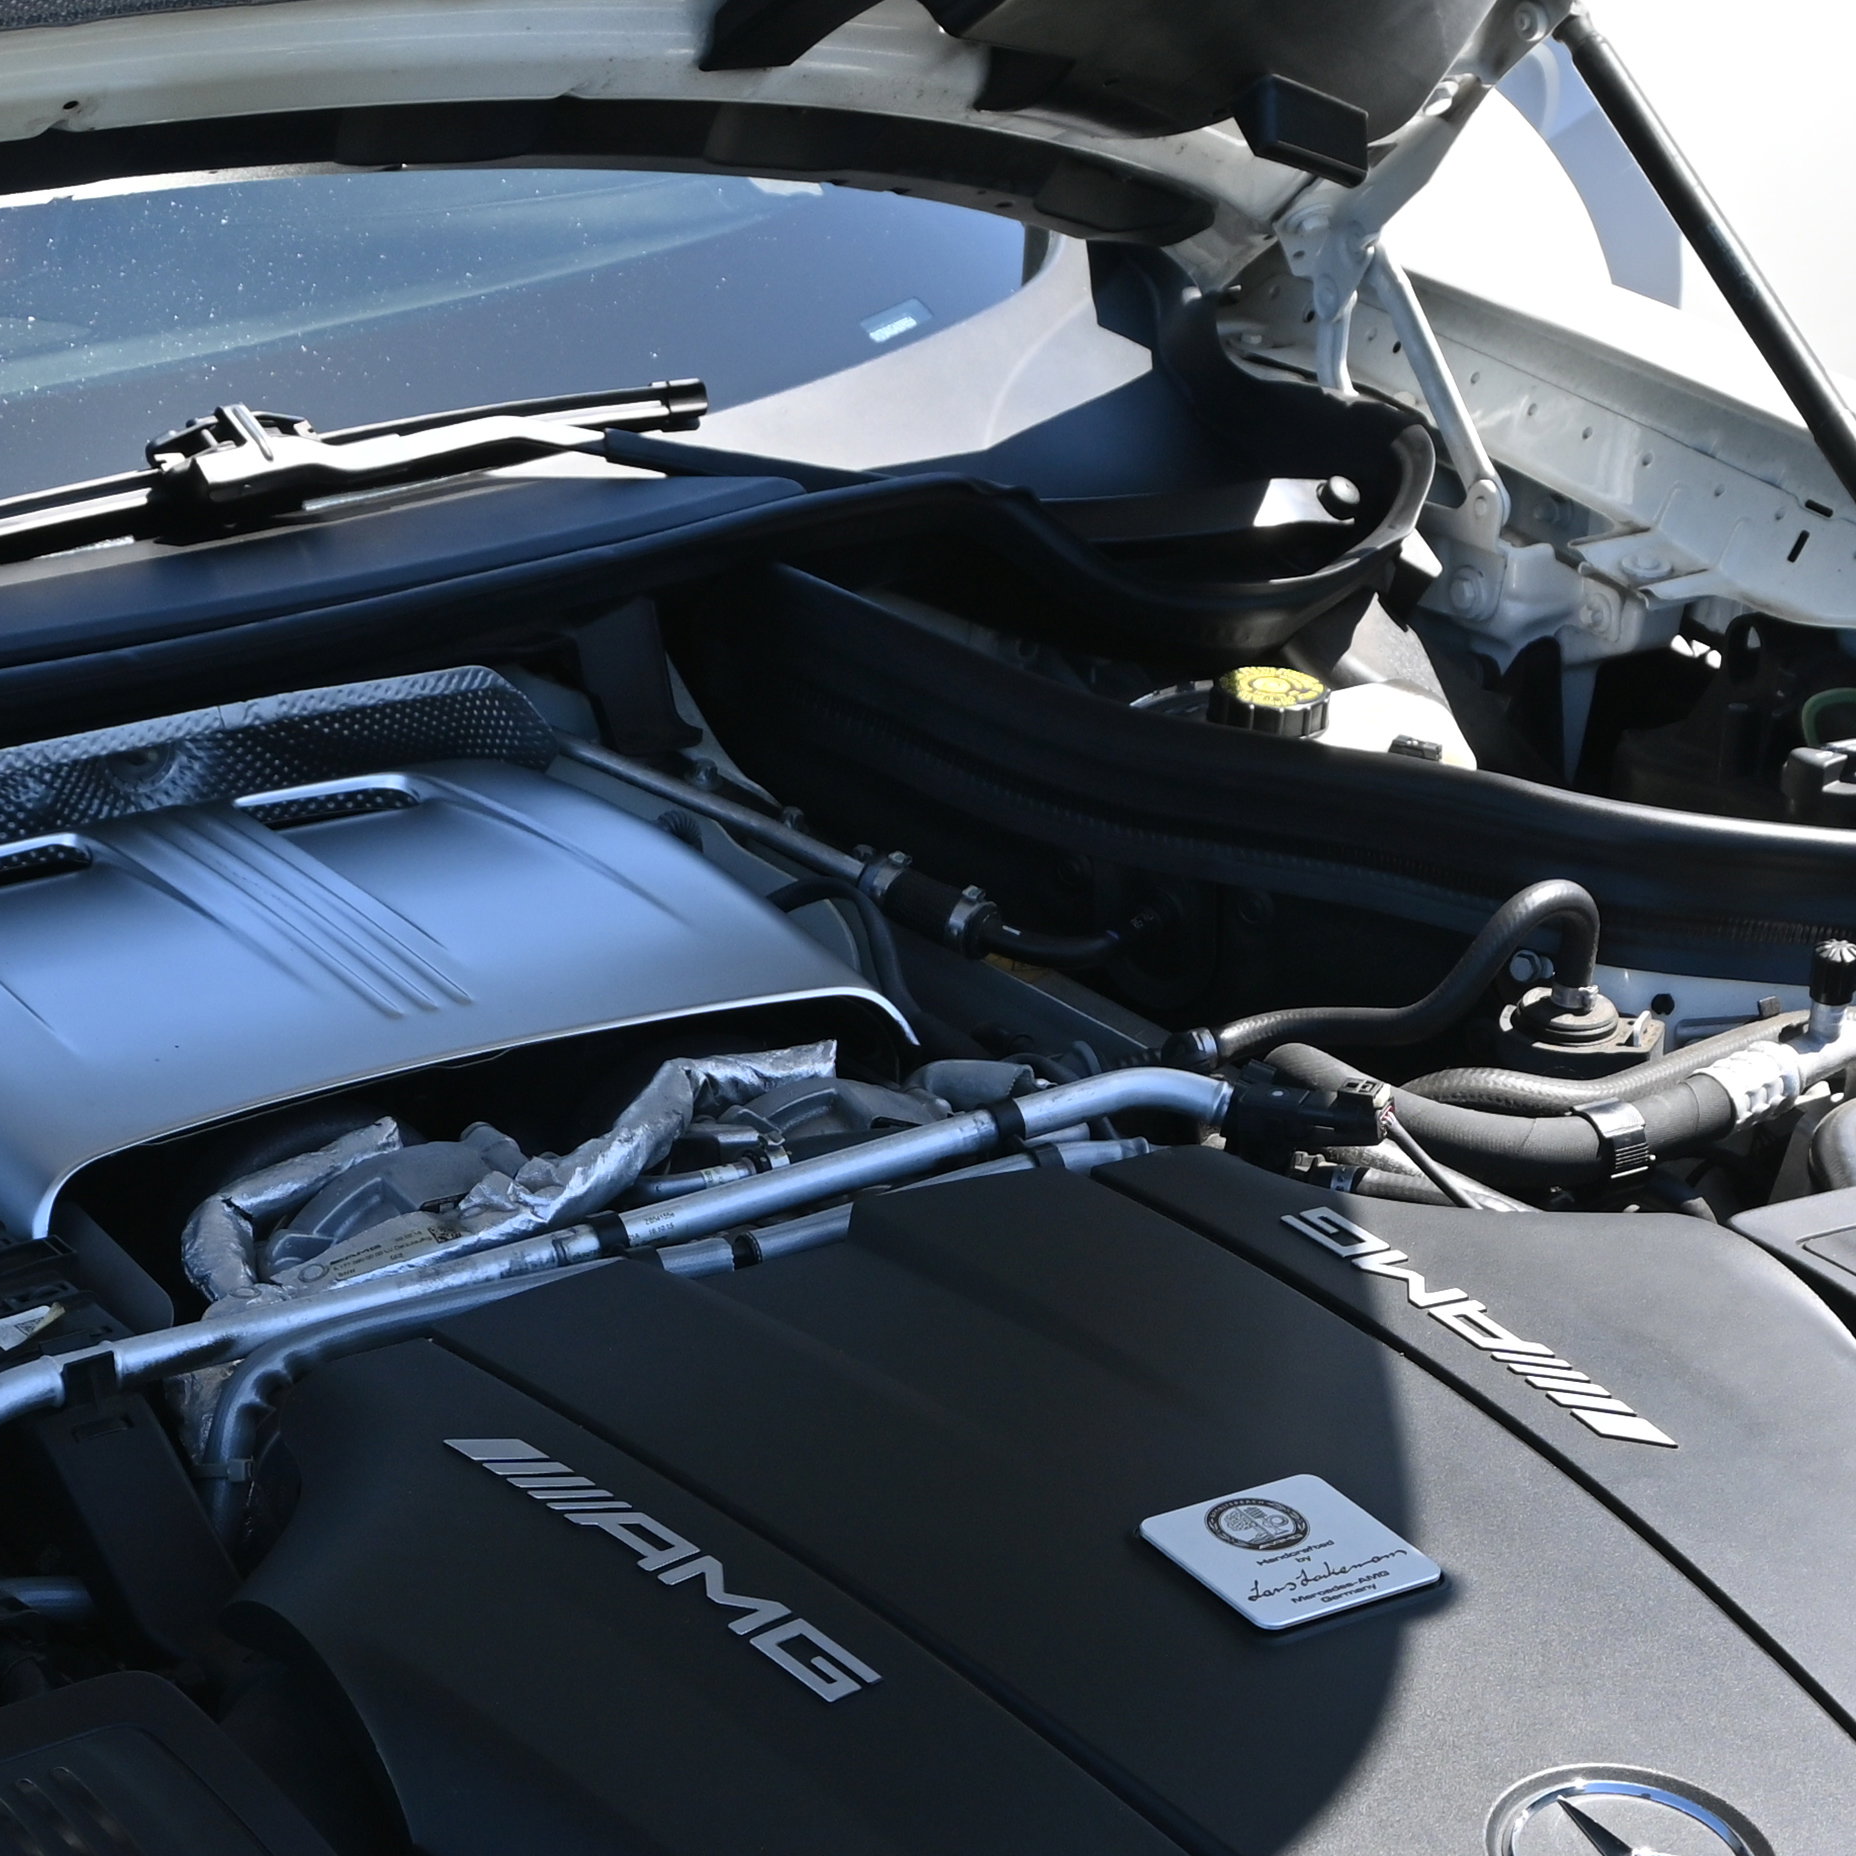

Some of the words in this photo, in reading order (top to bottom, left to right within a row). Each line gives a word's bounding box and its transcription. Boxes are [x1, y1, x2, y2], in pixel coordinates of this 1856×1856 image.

[1256, 1539, 1335, 1566] Handcrafted
[1295, 1555, 1312, 1564] by
[1290, 1570, 1390, 1604] Mercedes-AMG
[1320, 1583, 1377, 1603] Germany
[564, 1511, 883, 1702] AMG
